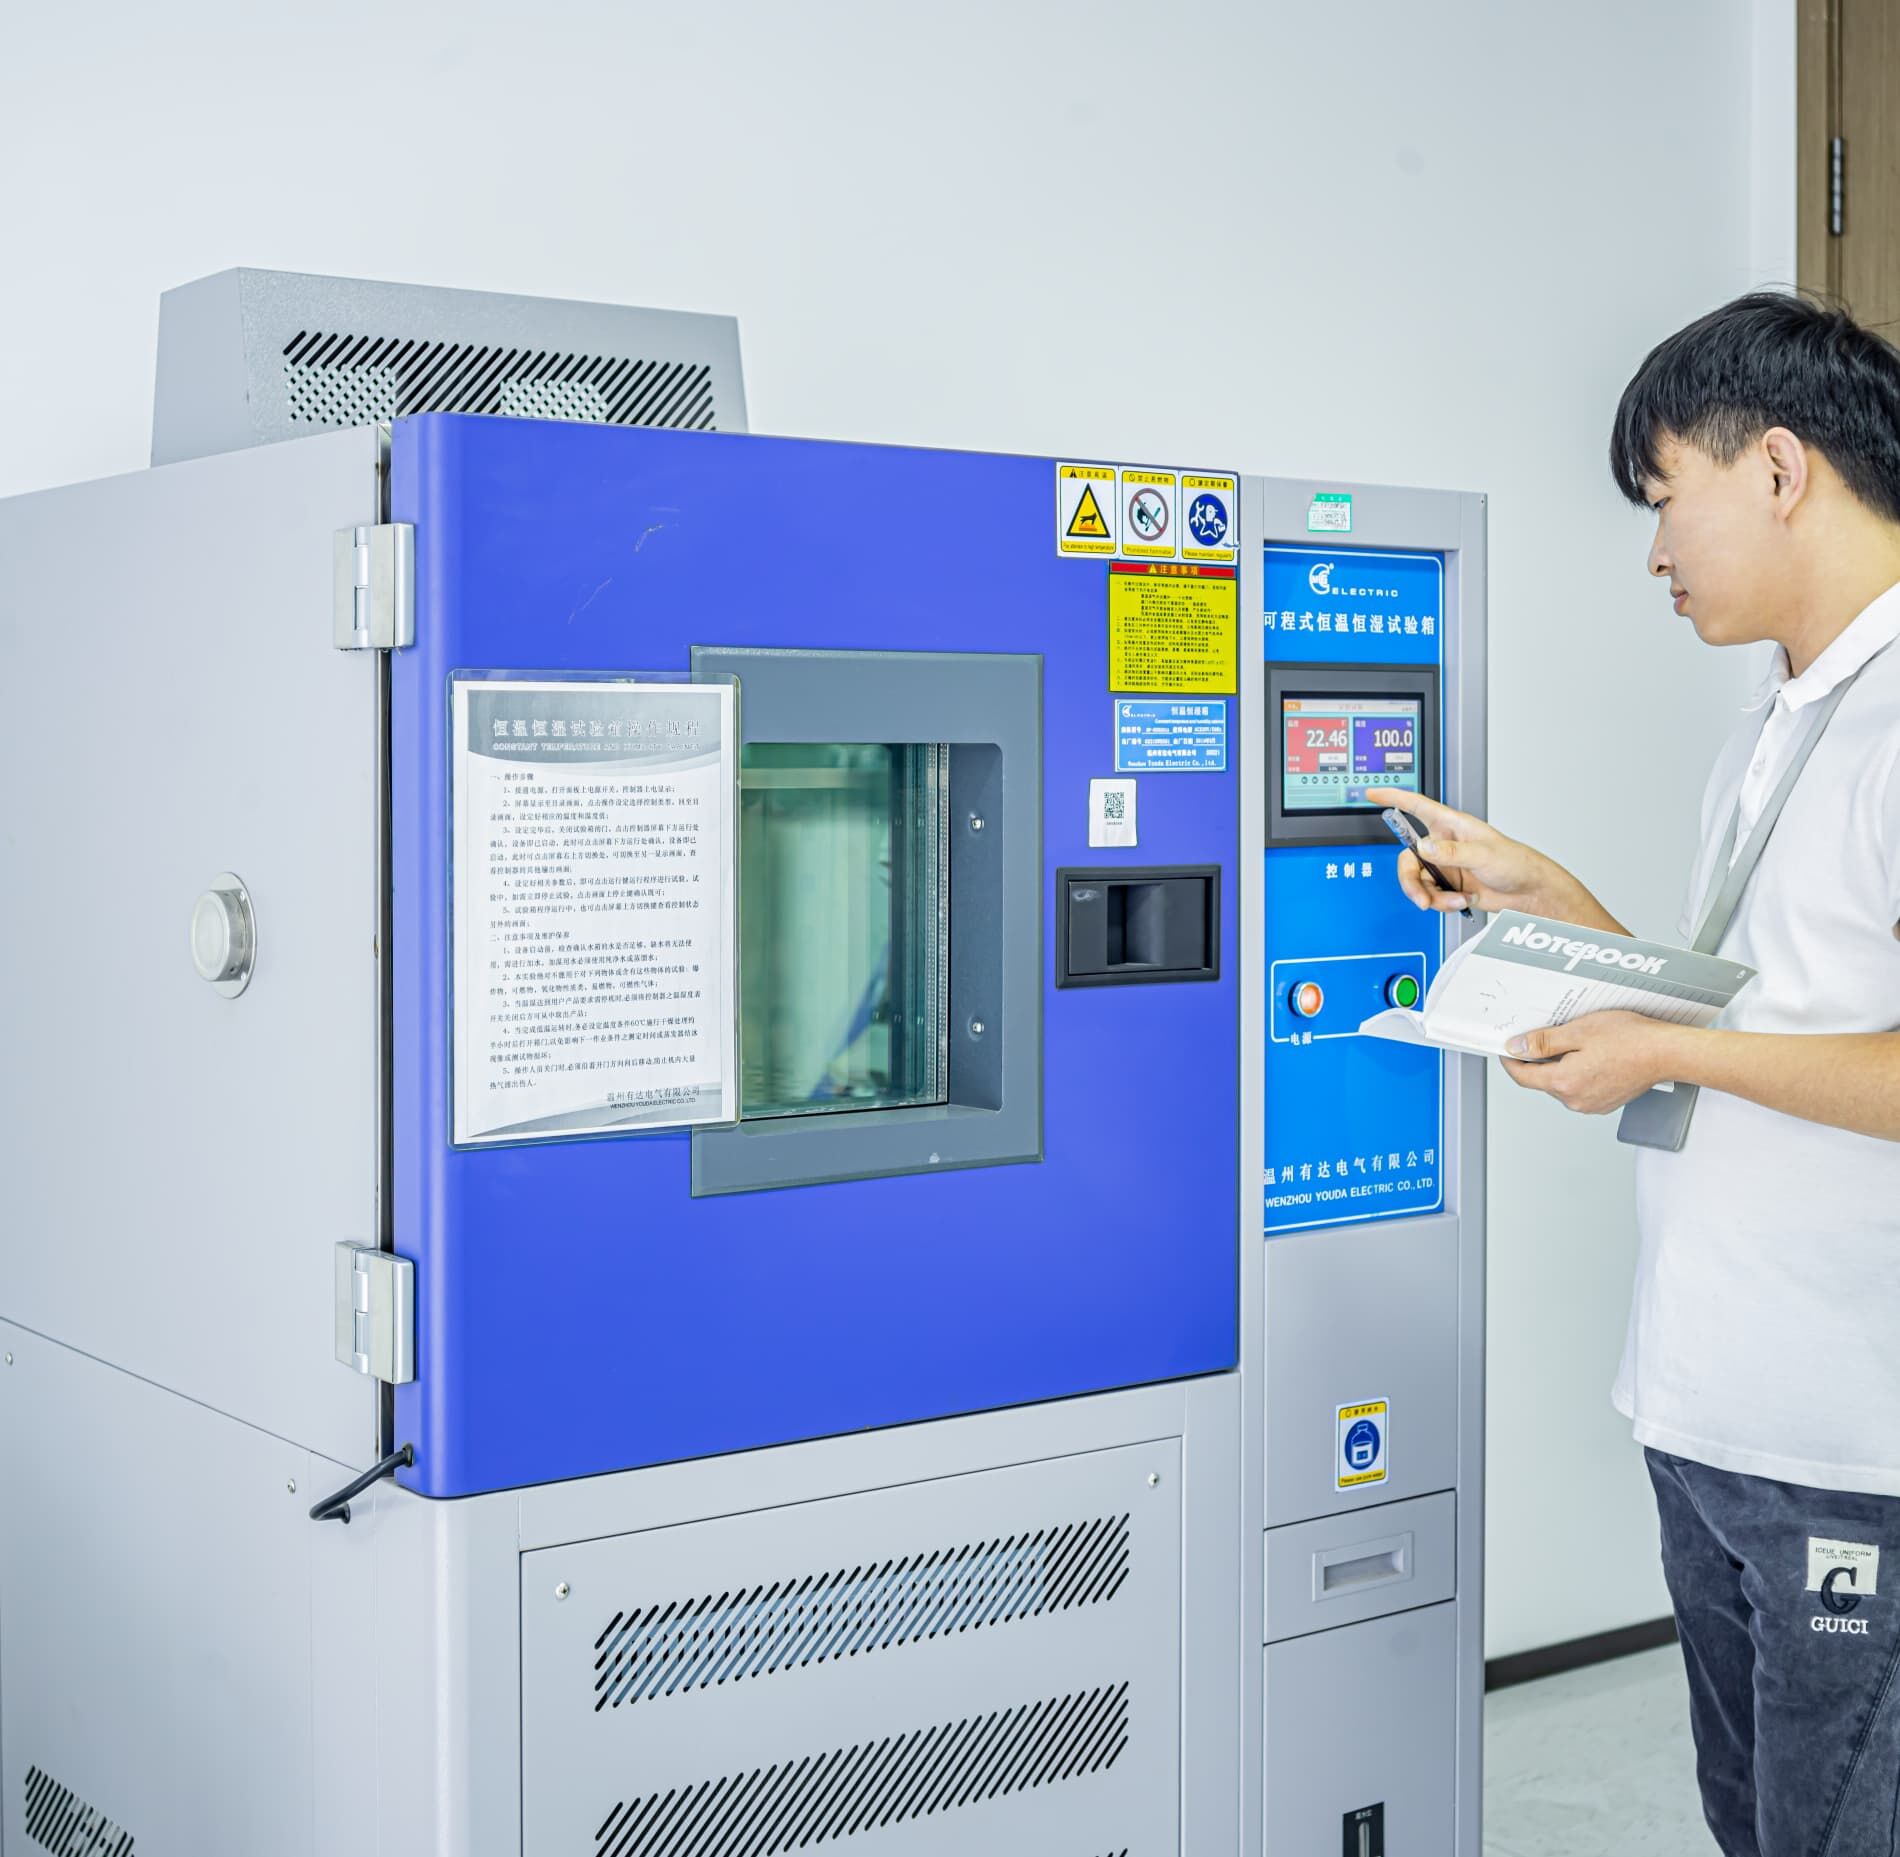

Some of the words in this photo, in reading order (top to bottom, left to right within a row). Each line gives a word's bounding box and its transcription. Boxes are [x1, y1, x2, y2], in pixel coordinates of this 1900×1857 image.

[1332, 588, 1399, 598] ELECTRIC
[1264, 610, 1435, 636] 可程式恒温恒湿试验箱
[493, 719, 701, 737] 恒温恒湿试验箱操作规程
[1306, 729, 1348, 748] 22.46
[1373, 729, 1413, 748] 100.0
[1326, 862, 1373, 880] 控制器
[1502, 922, 1669, 976] NOTEBOOK
[1291, 1031, 1312, 1046] 电源
[607, 1086, 700, 1102] 温州有达电气有限公司
[1264, 1149, 1435, 1186] 温州有达电气有限公司
[1265, 1193, 1312, 1209] WENZHOU
[1315, 1188, 1347, 1202] YOUDA
[1350, 1181, 1394, 1198] ELECTRIC
[1821, 1567, 1862, 1615] G
[1811, 1616, 1869, 1635] GUICI
